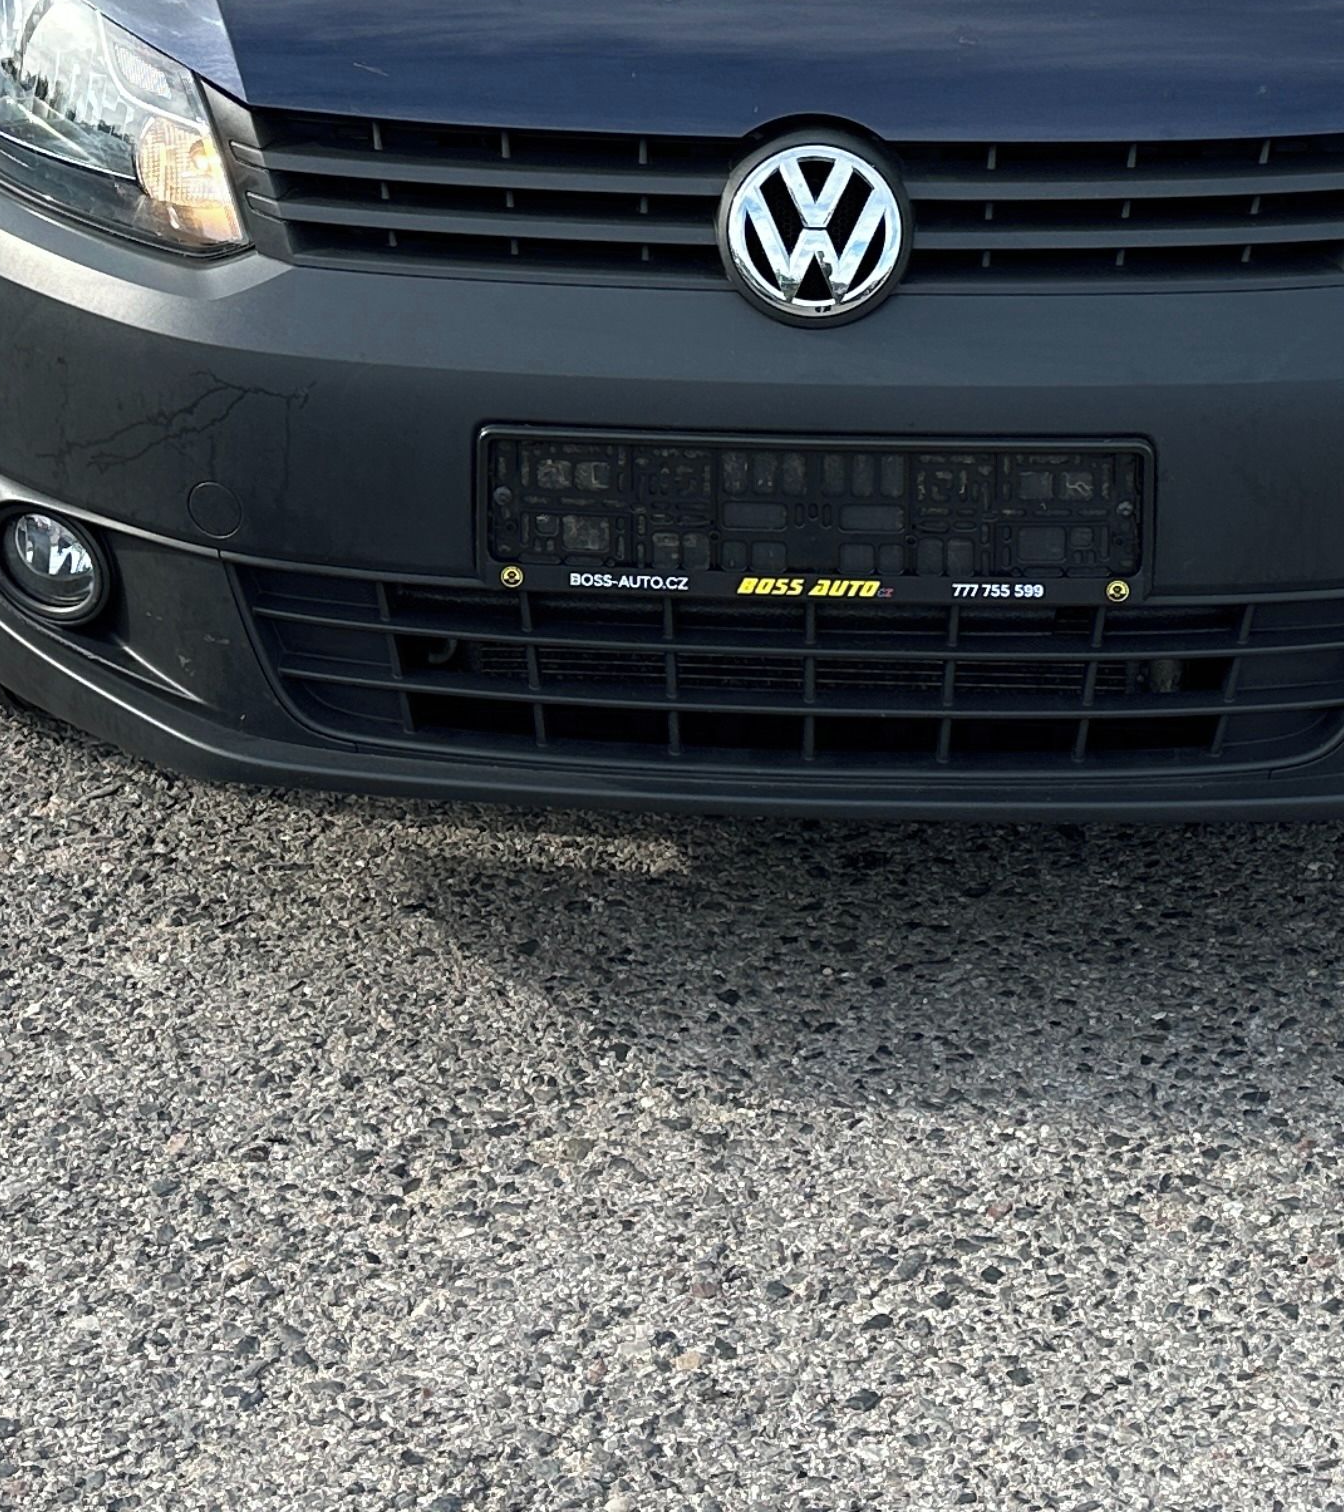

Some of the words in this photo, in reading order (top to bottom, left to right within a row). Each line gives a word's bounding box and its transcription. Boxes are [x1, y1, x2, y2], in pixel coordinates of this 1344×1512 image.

[569, 573, 688, 591] BOSS-AUTO.CZ
[737, 577, 804, 595] BOSS
[808, 579, 881, 597] AUTO
[952, 584, 978, 597] 777
[983, 584, 1010, 598] 755
[1014, 584, 1044, 598] 599
